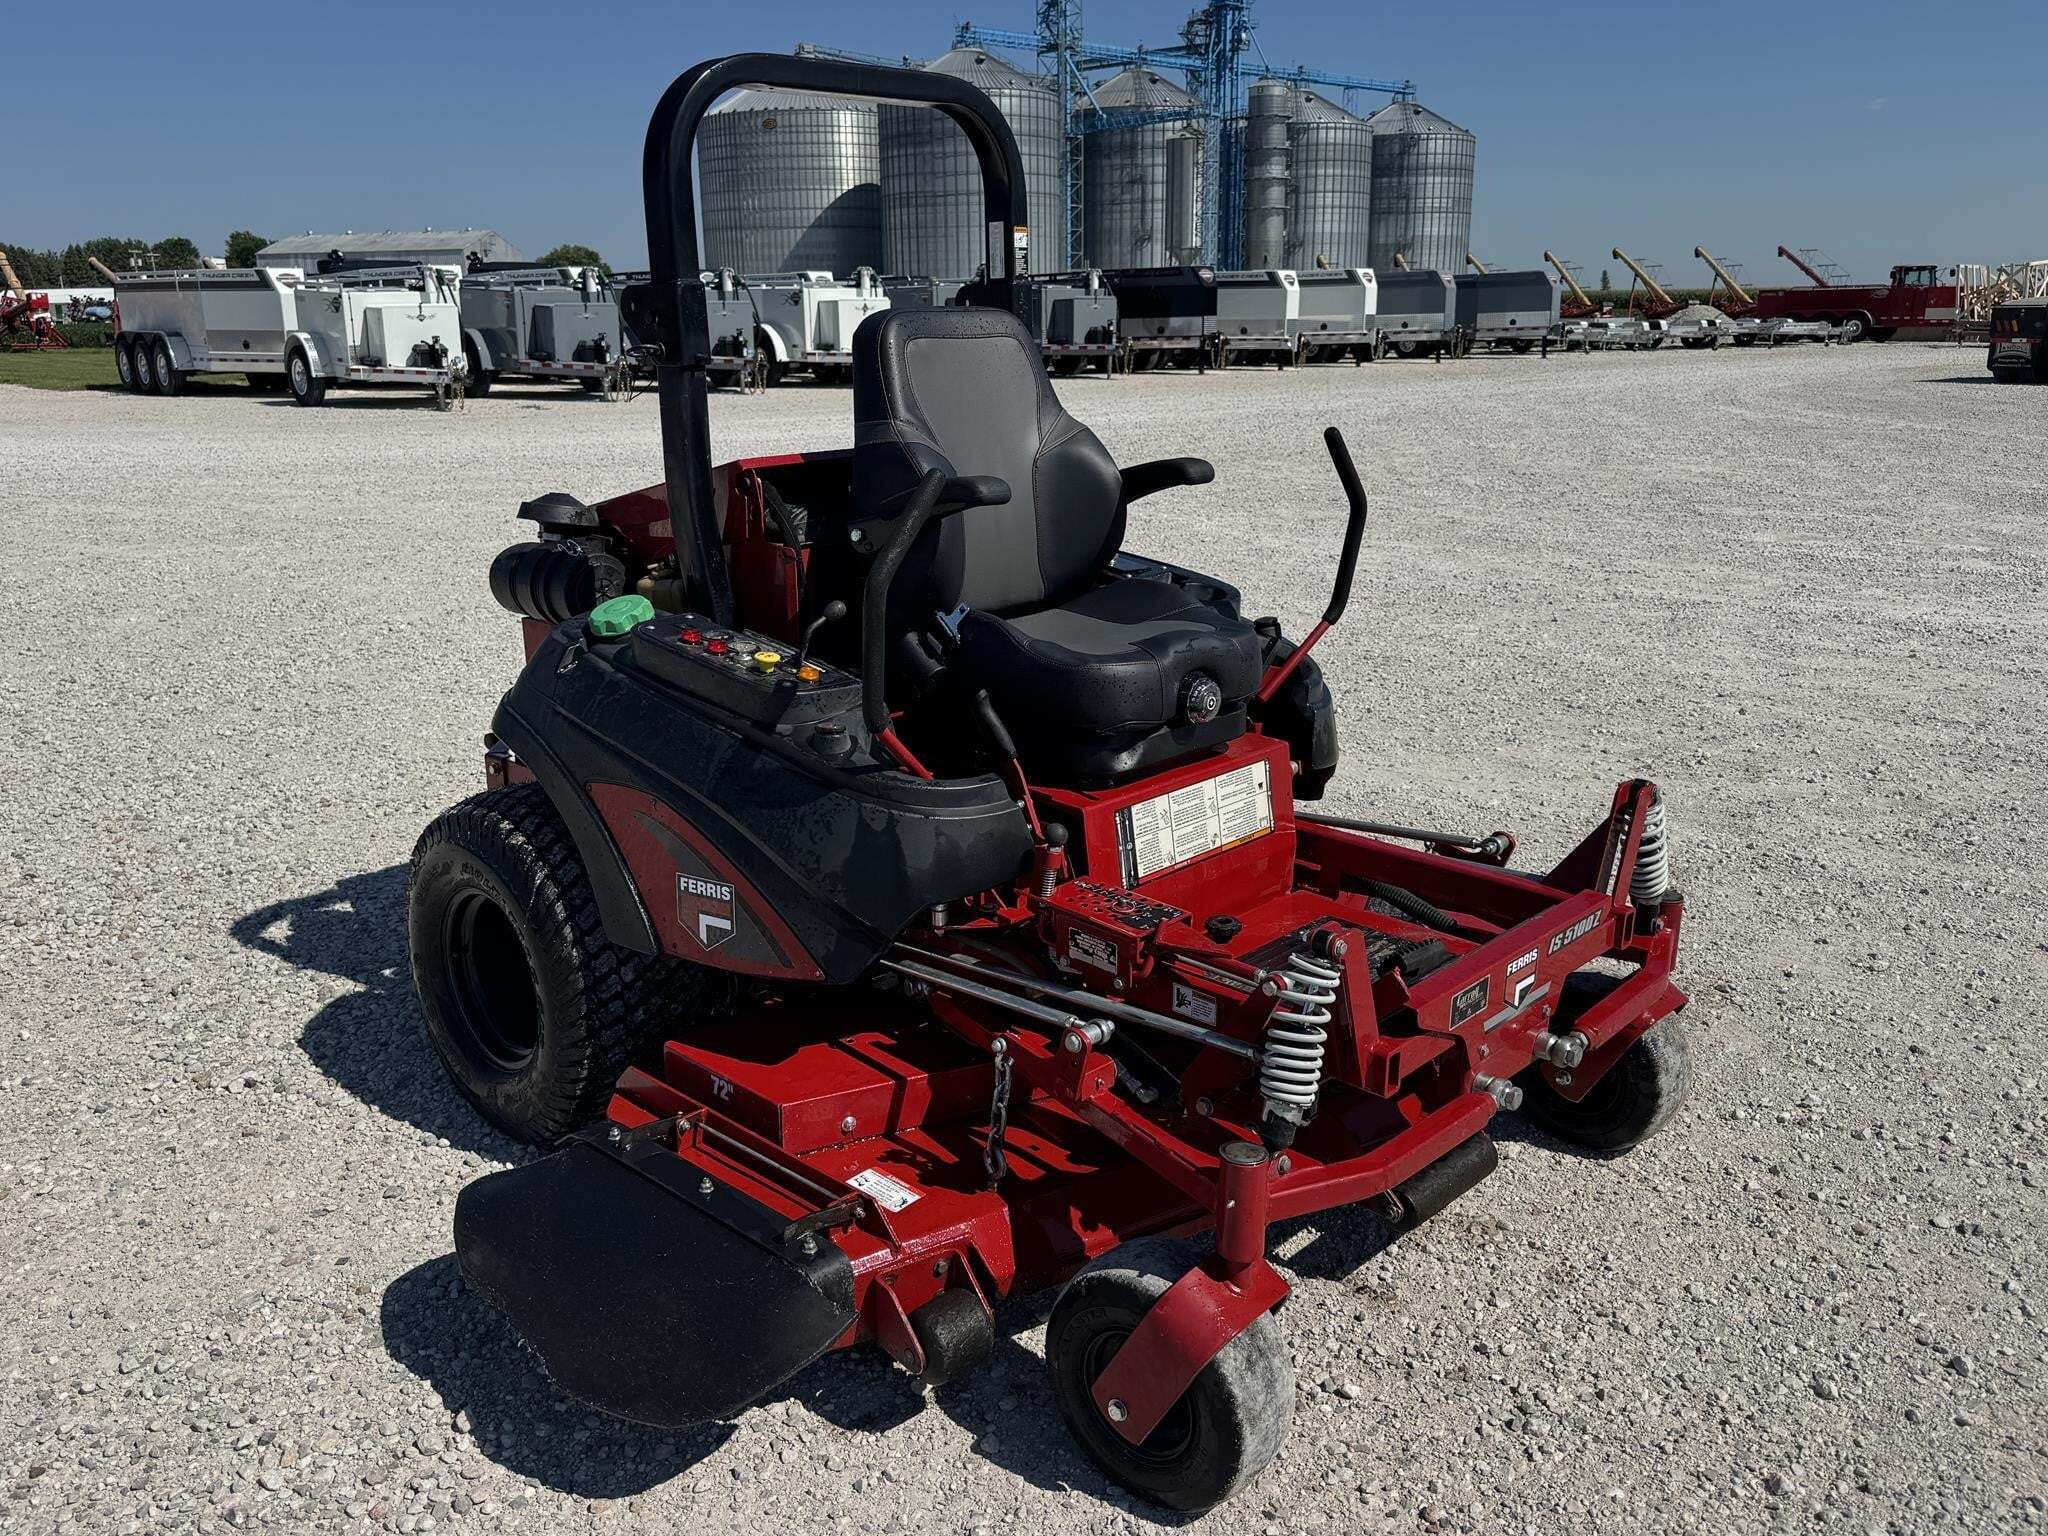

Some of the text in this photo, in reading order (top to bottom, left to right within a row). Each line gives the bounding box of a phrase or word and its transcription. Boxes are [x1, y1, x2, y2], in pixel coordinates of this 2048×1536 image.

[679, 876, 731, 901] FERRIS
[1548, 932, 1564, 955] IS
[1506, 948, 1538, 977] FERRIS
[710, 1074, 734, 1101] 72"
